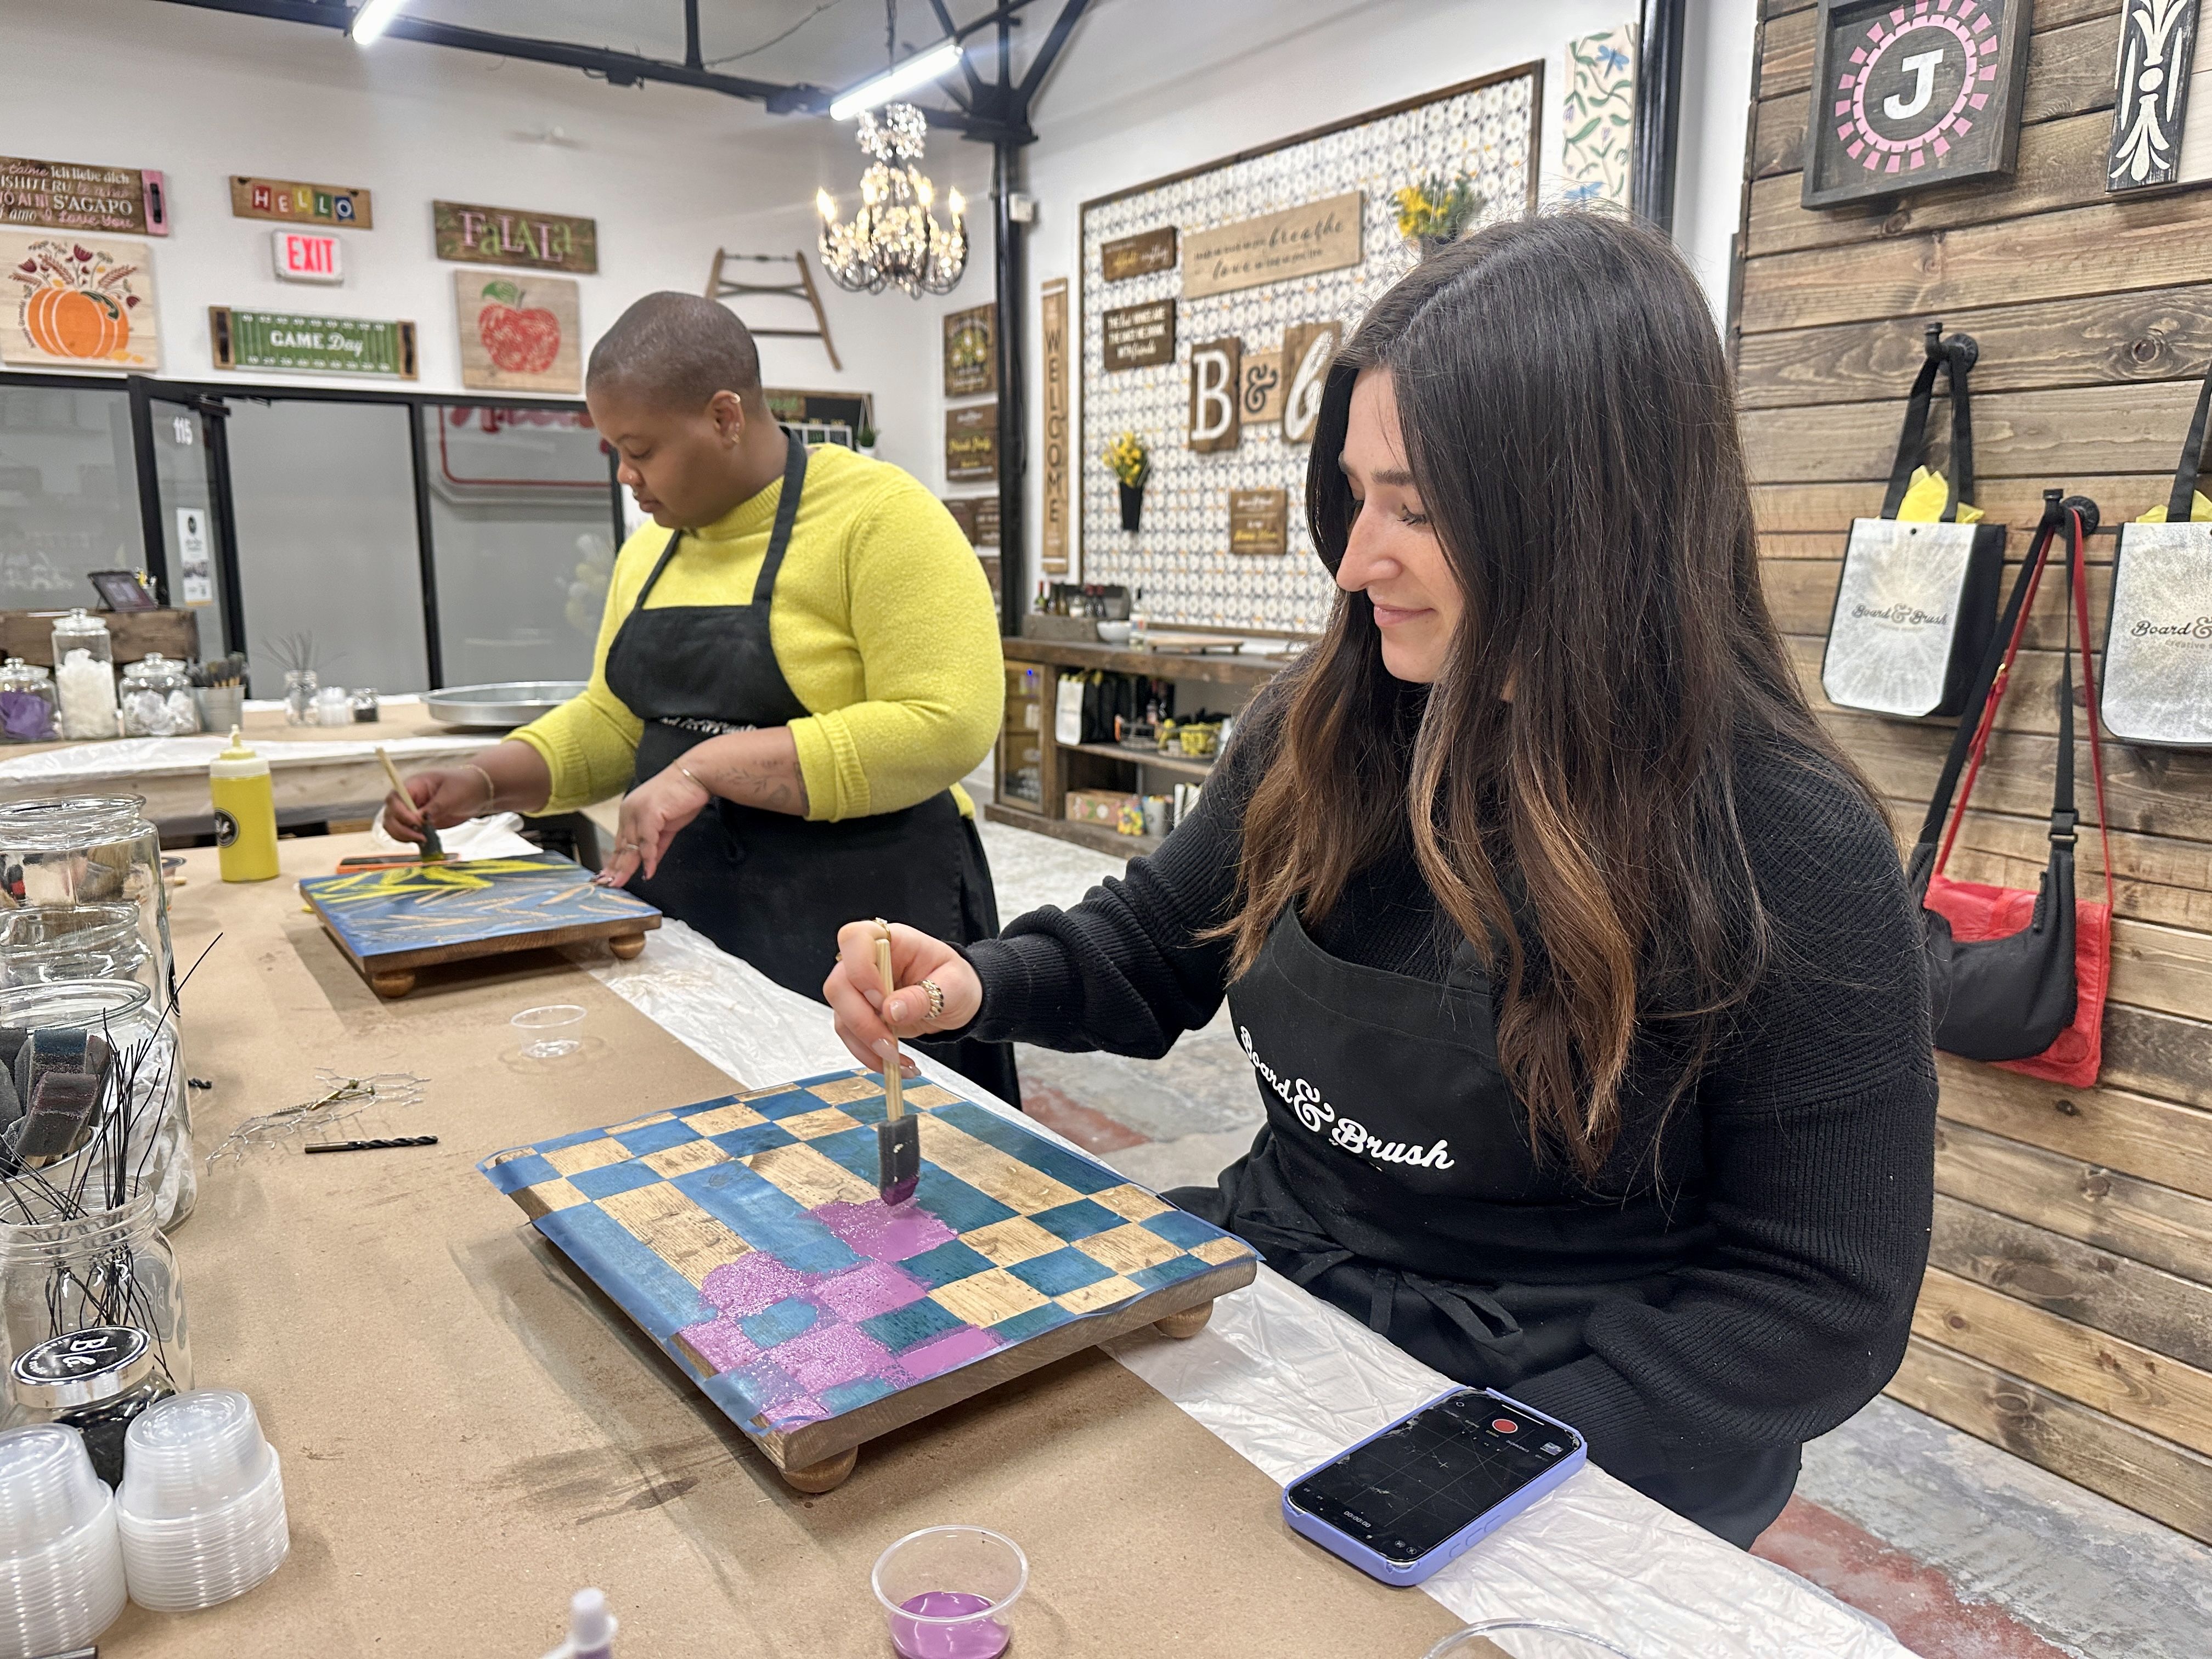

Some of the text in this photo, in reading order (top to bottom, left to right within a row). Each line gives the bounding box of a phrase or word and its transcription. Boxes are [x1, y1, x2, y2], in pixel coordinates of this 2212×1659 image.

[1883, 49, 1944, 120] J
[54, 194, 133, 216] S'AGAPO
[254, 189, 352, 217] HELLO
[286, 234, 334, 274] EXIT
[270, 330, 363, 358] GAME Day
[173, 416, 193, 445] 115
[1045, 328, 1062, 523] WELCOME
[1852, 603, 1892, 619] Board
[1909, 609, 1949, 626] Brush
[2131, 620, 2192, 637] Board
[2165, 640, 2205, 649] creative
[1240, 1025, 1455, 1170] Board & Brush
[1344, 1510, 1372, 1528] 00:00:00
